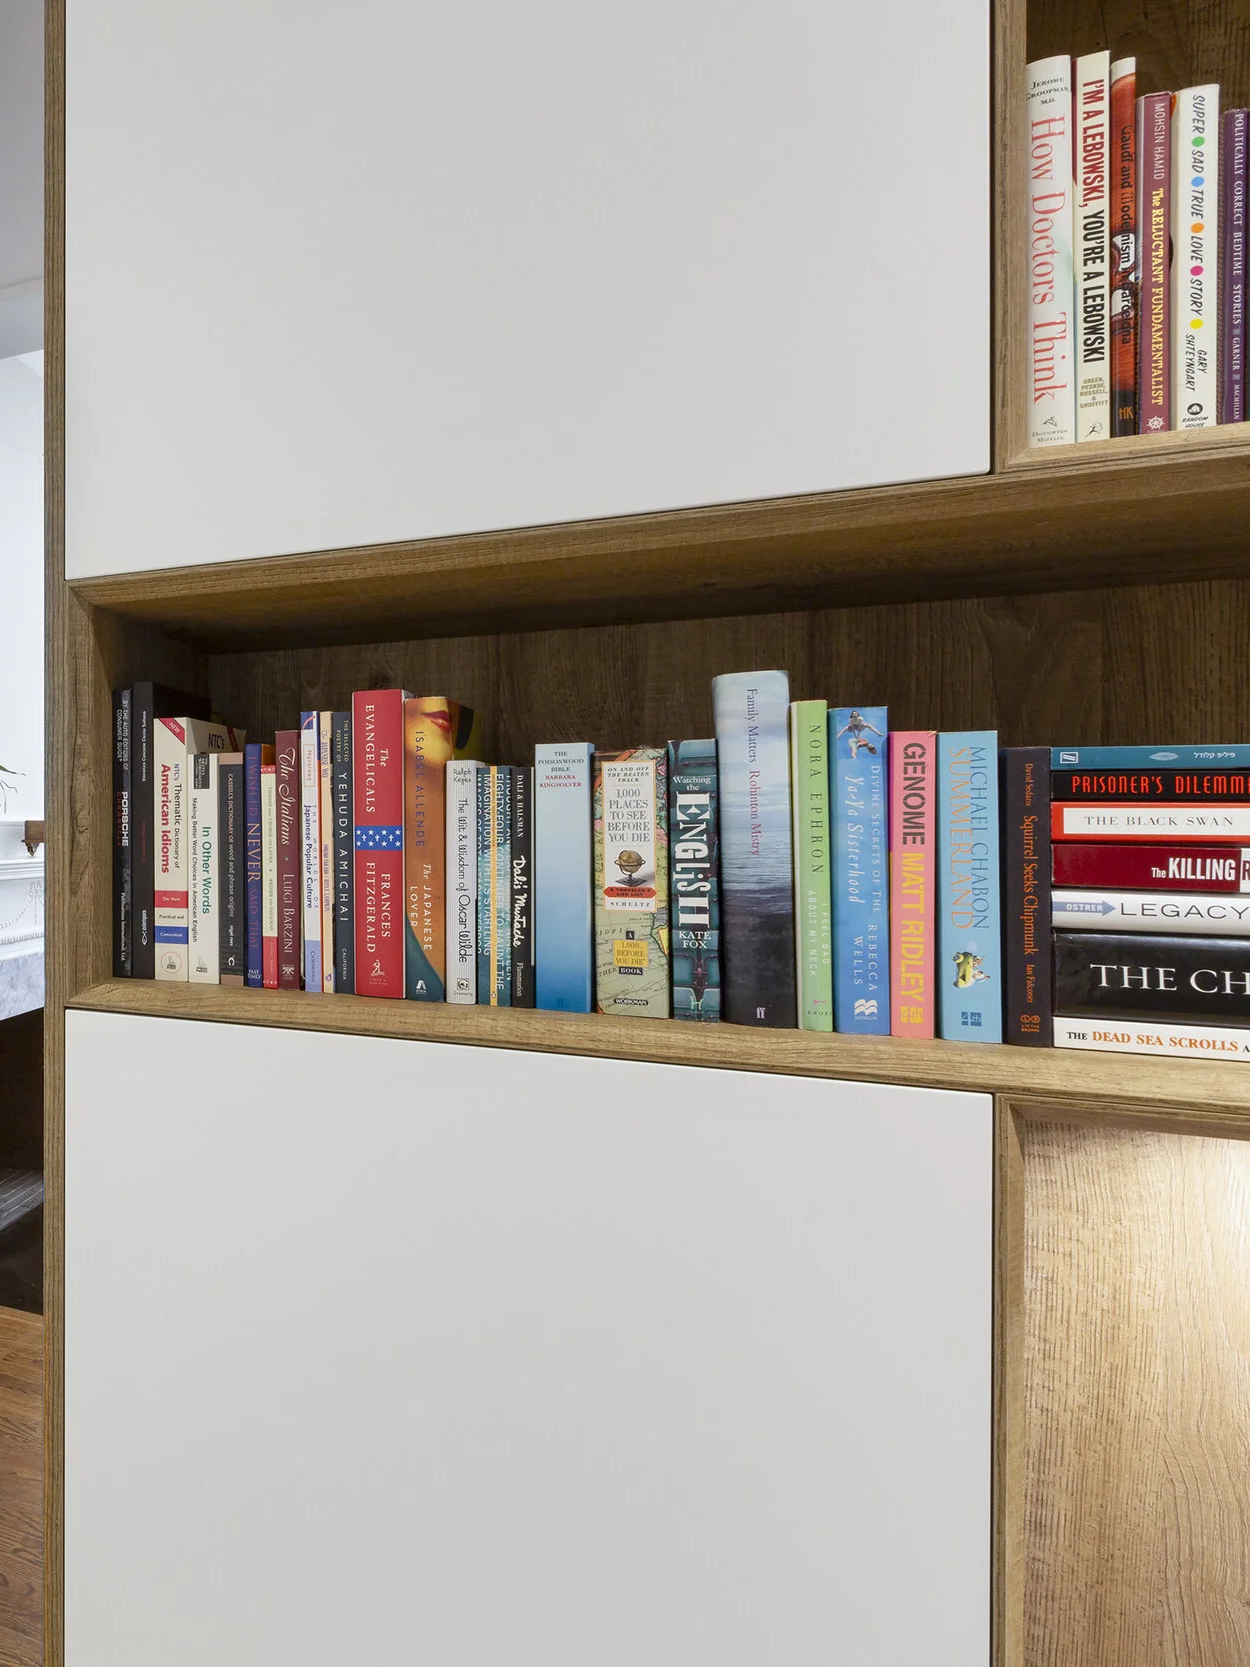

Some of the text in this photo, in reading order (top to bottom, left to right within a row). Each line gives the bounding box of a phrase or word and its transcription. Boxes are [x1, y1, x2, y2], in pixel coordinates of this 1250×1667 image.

[1031, 78, 1064, 90] JEROME
[1153, 103, 1165, 180] MOHSIN HAMID
[1233, 113, 1244, 175] POLITICALLY
[1079, 79, 1105, 363] I'M A LEBOWSKI, YOU'RE A LEBOWSKI
[1190, 95, 1205, 316] SUPER SAD TRUE LOVE STORY
[1234, 181, 1243, 226] CORRECT
[1030, 115, 1068, 404] How Doctors Think
[1233, 232, 1243, 276] BEDTIME
[1151, 188, 1165, 405] The RELUCTANT FUNDAMENTALIST
[1232, 285, 1242, 324] STORIES
[1184, 334, 1197, 392] SHTEYNGART
[1196, 349, 1208, 374] GARY
[1232, 337, 1240, 371] GARNER
[1119, 407, 1134, 419] HK
[744, 688, 759, 764] Family Matters
[365, 704, 375, 813] EVANGELICALS
[380, 748, 389, 767] The
[278, 747, 295, 846] The Italians
[415, 731, 425, 847] ISABEL ALLENDE
[616, 789, 640, 798] 1,000
[673, 776, 711, 785] Watching
[809, 724, 824, 874] NORA EPHRON
[902, 743, 926, 845] GENOME
[1025, 763, 1034, 806] David Sedaris
[1072, 776, 1250, 794] PRISONER'S DILEMM
[161, 764, 172, 874] American Idioms
[173, 784, 182, 825] Thematic
[303, 805, 312, 841] Japanese
[458, 798, 468, 813] The
[458, 816, 468, 833] Wit
[609, 800, 648, 810] PLACES
[609, 811, 647, 820] TO SEE
[748, 770, 762, 856] Rohinton Mistry
[1084, 816, 1234, 826] THE BLACK SWAN
[338, 772, 349, 922] YEHUDA AMICHAI
[607, 822, 650, 831] BEFORE
[608, 833, 650, 842] YOU DIE
[844, 776, 865, 904] Ya-Ya Sisterhood
[870, 765, 882, 913] DIVINE SECRETS OF THE
[949, 747, 974, 929] SUMMERLAND
[970, 746, 990, 929] MICHAEL CHABON
[174, 859, 180, 869] of
[202, 826, 212, 914] In Other Words
[247, 823, 260, 884] NEVER
[304, 843, 312, 875] Popular
[458, 844, 468, 879] Wisdom
[1151, 868, 1166, 878] The
[1168, 858, 1236, 880] KILLING
[381, 873, 391, 938] FRANCES
[455, 881, 469, 891] of
[1020, 815, 1039, 955] Squirrel Seeks Chipmunk
[283, 874, 294, 953] LUIGI BARZINI
[366, 862, 376, 953] FITZGERALD
[410, 886, 418, 927] LOVER
[423, 863, 432, 951] The JAPANESE
[458, 894, 471, 929] Oscar
[512, 893, 528, 947] Mustache
[821, 912, 829, 940] FEEL
[901, 852, 925, 1000] MATT RIDLEY
[1066, 903, 1103, 911] OSTRER
[1121, 902, 1250, 919] LEGACY
[458, 930, 473, 963] Wilde
[678, 931, 711, 940] KATE
[683, 940, 708, 949] FOX
[808, 890, 818, 977] ABOUT MY NECK
[821, 944, 829, 964] BAD
[853, 936, 863, 985] WELLS
[867, 924, 878, 991] REBECCA
[1090, 964, 1177, 991] THE
[1025, 964, 1035, 1003] Ian Falconer
[1066, 1032, 1087, 1040] THE
[1093, 1031, 1131, 1043] DEAD
[1136, 1034, 1163, 1046] SEA
[1169, 1037, 1238, 1051] SCROLLS
